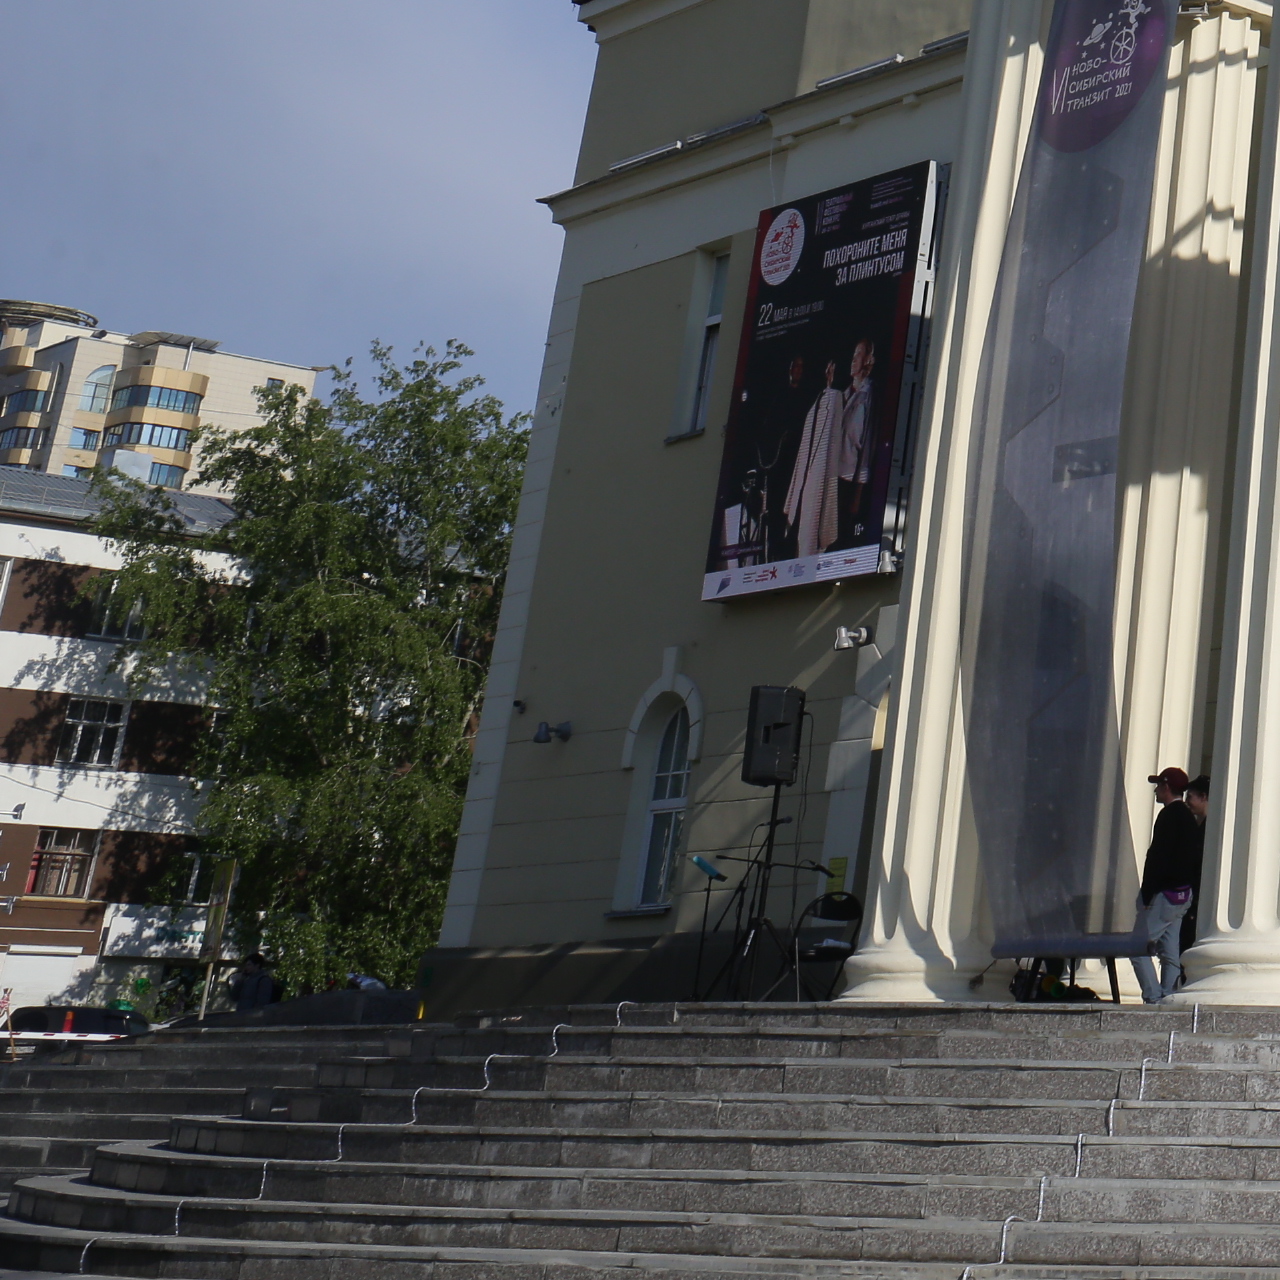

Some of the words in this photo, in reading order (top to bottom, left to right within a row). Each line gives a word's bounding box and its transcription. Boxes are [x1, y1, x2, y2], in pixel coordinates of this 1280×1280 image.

[1068, 62, 1132, 94] СИБИРСКИЙ
[1071, 57, 1108, 76] НОВО-
[1066, 87, 1112, 113] ТРАНЗИТ
[1114, 82, 1132, 99] 2021
[823, 236, 881, 268] ПОХОРОНИТЕ
[881, 228, 908, 253] МЕНЯ
[835, 267, 848, 287] ЗА
[848, 251, 905, 283] ПЛИНТУСОМ
[758, 303, 773, 328] 22
